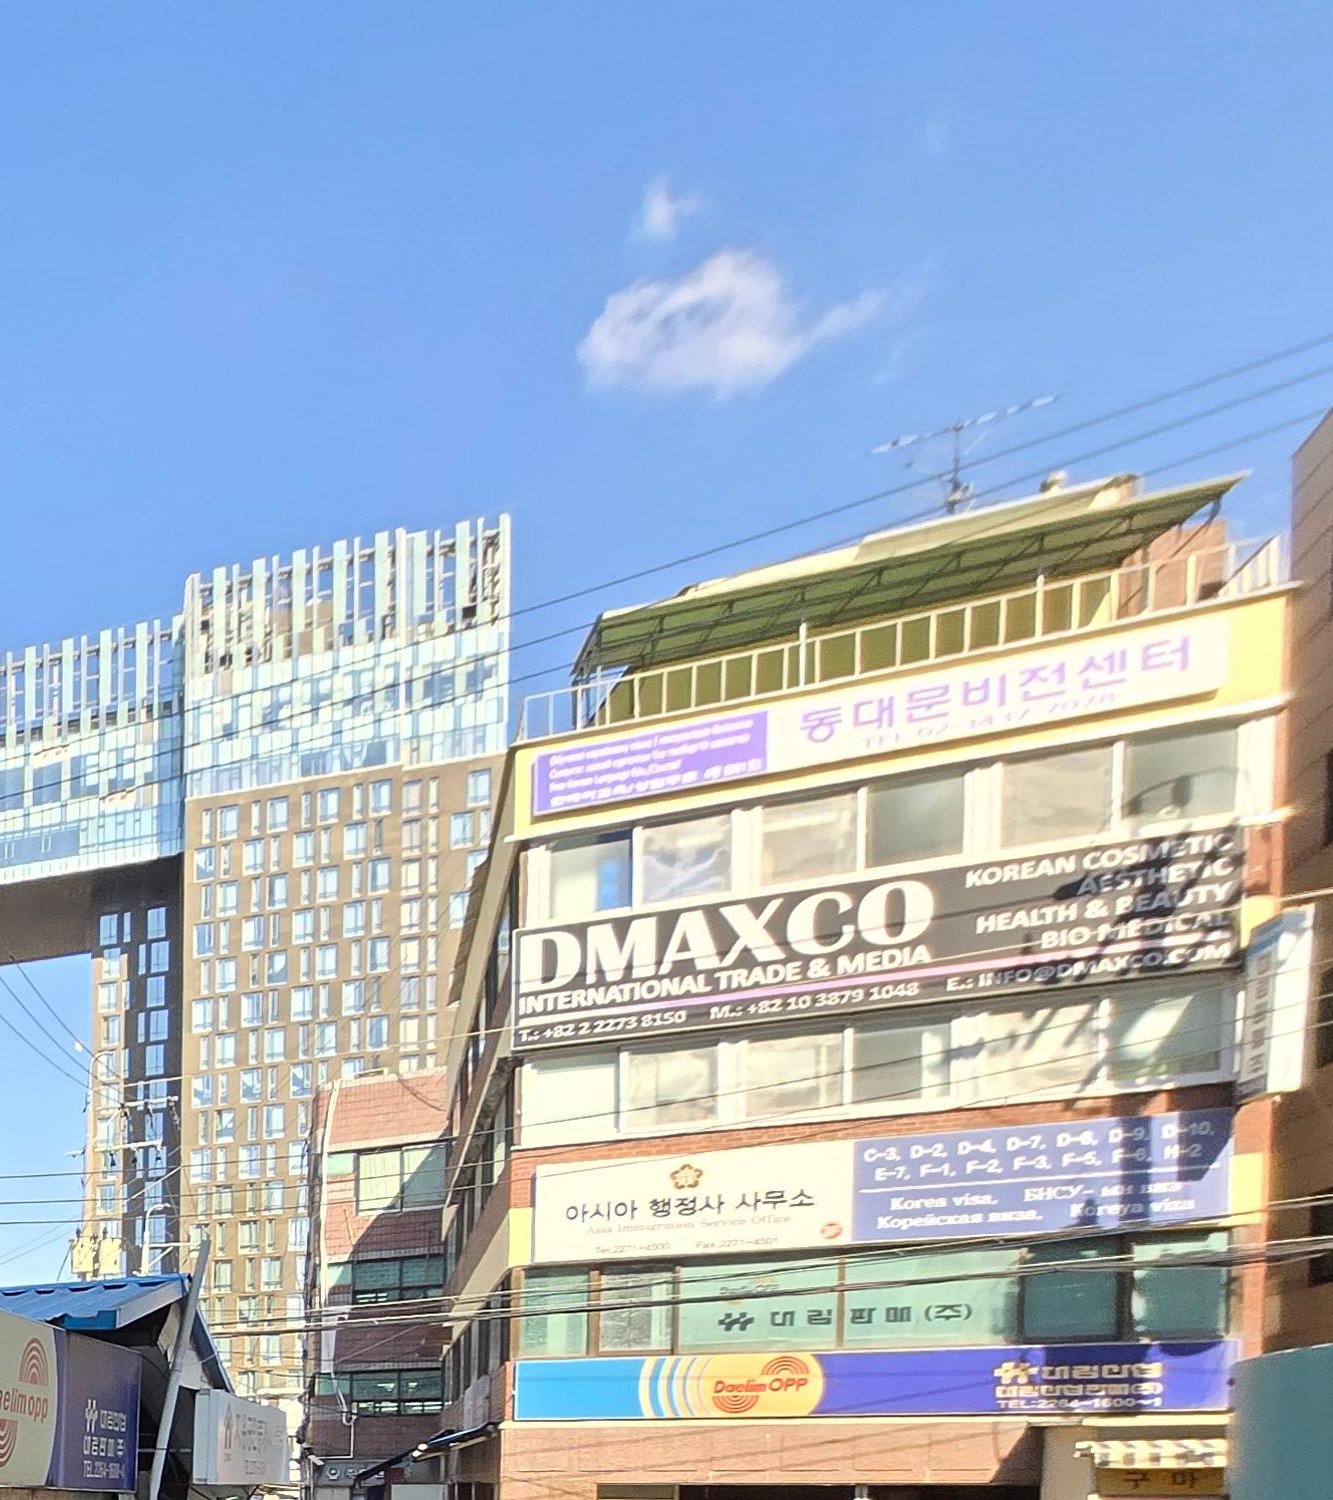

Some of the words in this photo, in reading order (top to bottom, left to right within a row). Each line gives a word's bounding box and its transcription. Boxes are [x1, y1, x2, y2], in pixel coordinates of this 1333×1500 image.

[800, 634, 1191, 744] 동대문비전센터
[965, 855, 1077, 889] KOREAN
[1082, 833, 1234, 871] COSMETIC
[1076, 857, 1234, 896] AESTHETIC
[976, 902, 1080, 935] HEALTH
[1084, 899, 1110, 919] &
[1114, 881, 1234, 917] BEAUTY
[519, 880, 935, 994] DMAXCO
[519, 973, 713, 1016] INTERNATIONAL
[713, 961, 803, 992] TRADE
[806, 957, 832, 979] &
[836, 944, 933, 975] MEDIA
[593, 1015, 638, 1033] 2273
[641, 1010, 687, 1027] 8150
[815, 987, 865, 1008] 3879
[978, 942, 1233, 988] INFO@DMAXCO.COM
[565, 1199, 638, 1223] 아시아
[648, 1194, 725, 1218] 행정사
[735, 1188, 816, 1211] 사무소
[890, 1197, 948, 1211] Korea
[1150, 1198, 1196, 1213] viza
[768, 1377, 809, 1392] OPP
